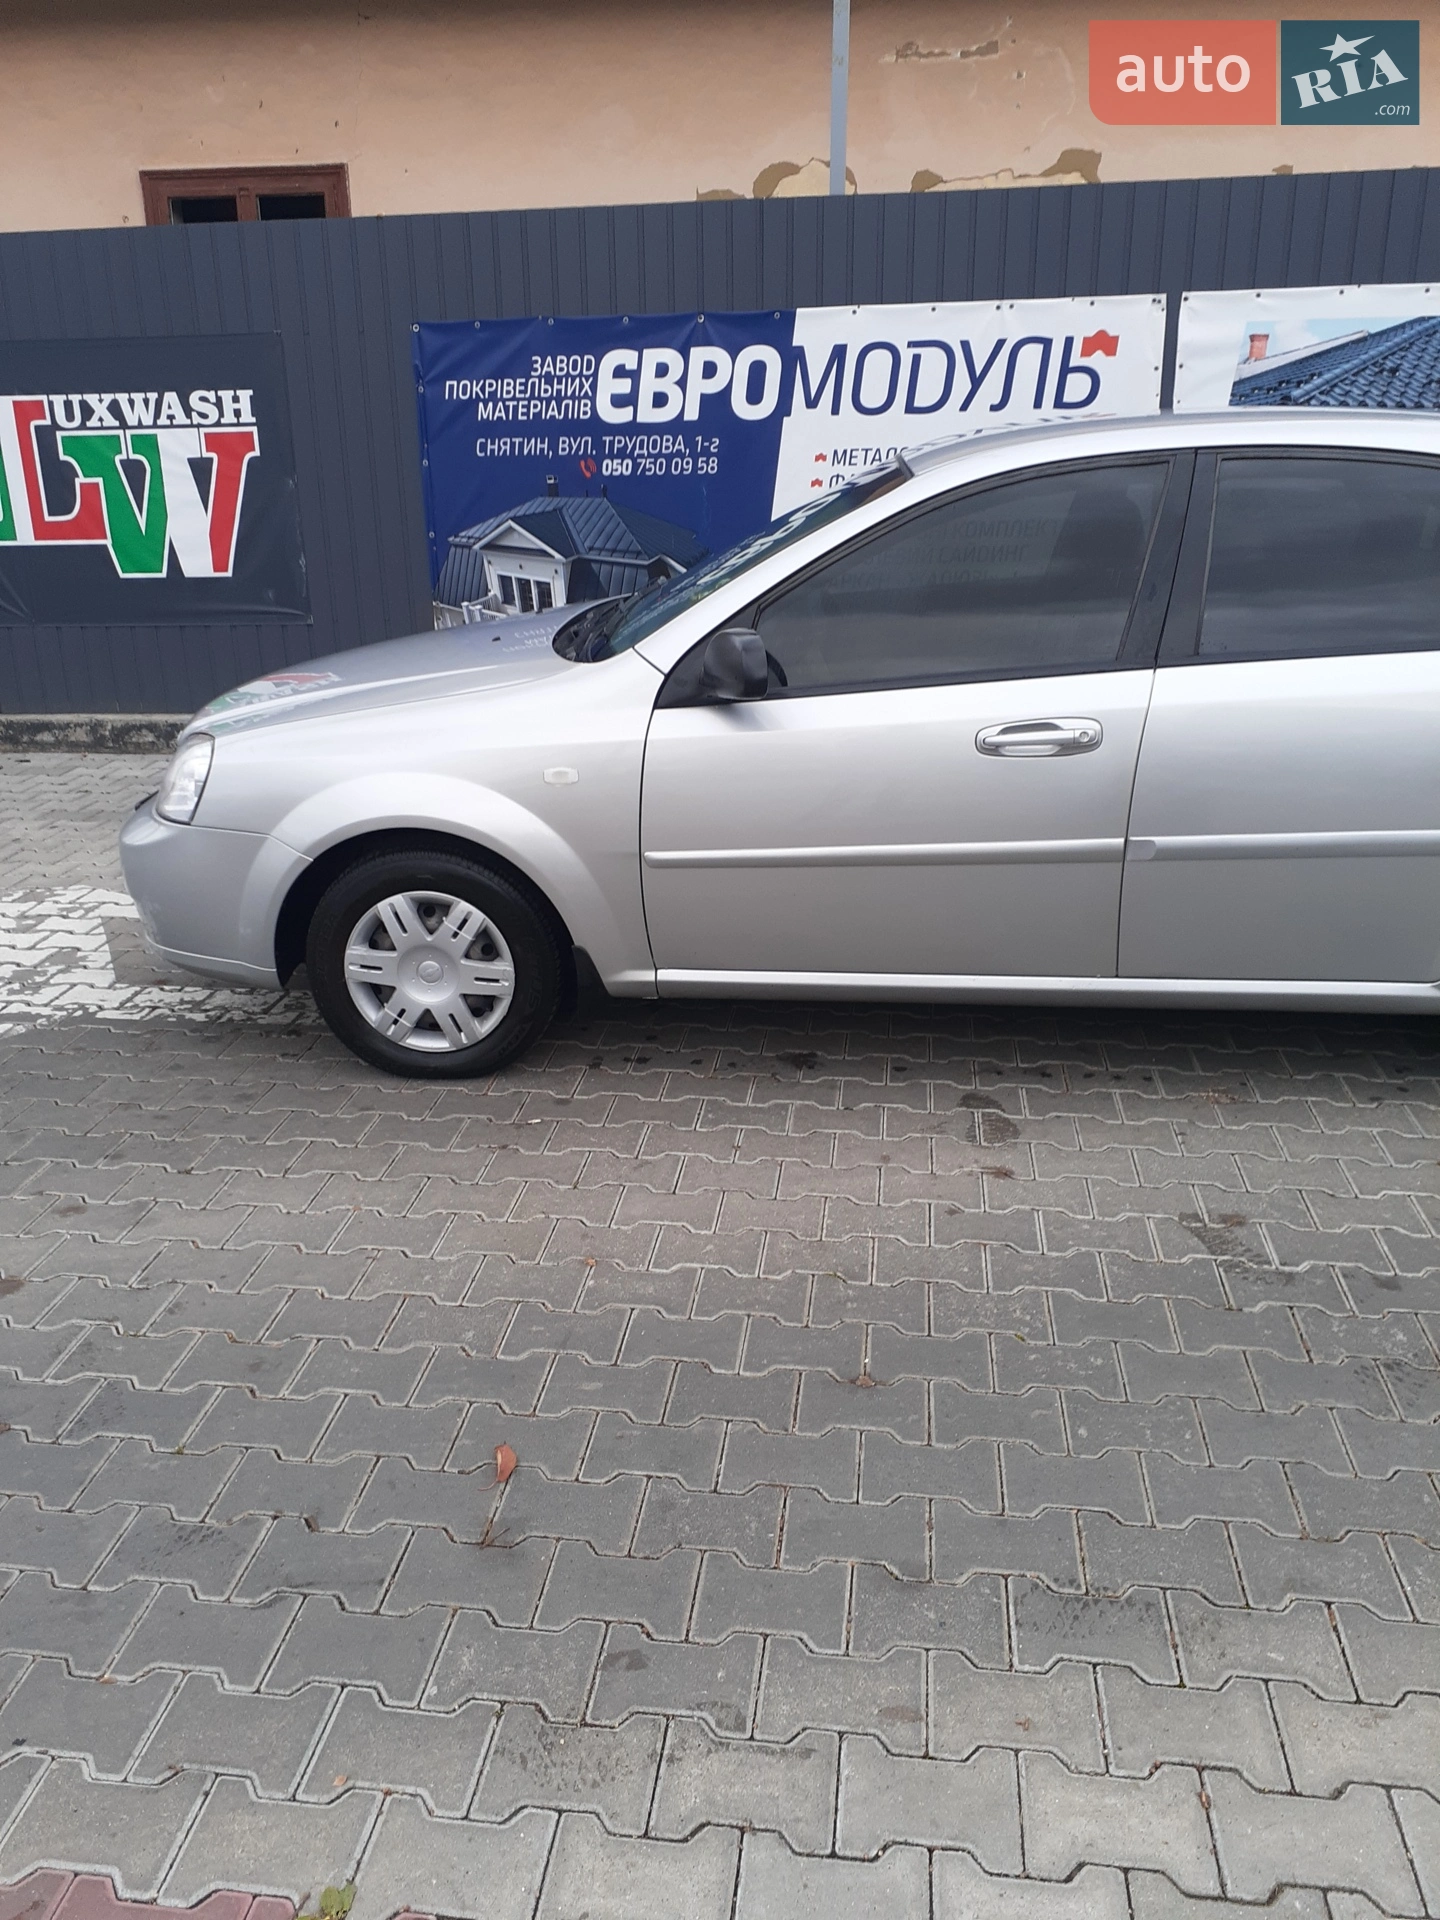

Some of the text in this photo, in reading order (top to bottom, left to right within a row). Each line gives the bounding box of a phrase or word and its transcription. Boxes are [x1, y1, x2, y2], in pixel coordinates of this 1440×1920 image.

[444, 377, 593, 400] ПОКРІВЕЛЬНИХ
[477, 400, 592, 421] МАТЕРІАЛІВ
[475, 437, 554, 459] СНЯТИН,
[558, 437, 597, 456] ВУЛ.
[602, 434, 690, 458] ТРУДОВА,
[831, 446, 909, 467] МЕТАЛ
[602, 456, 719, 476] 050 750 09 58
